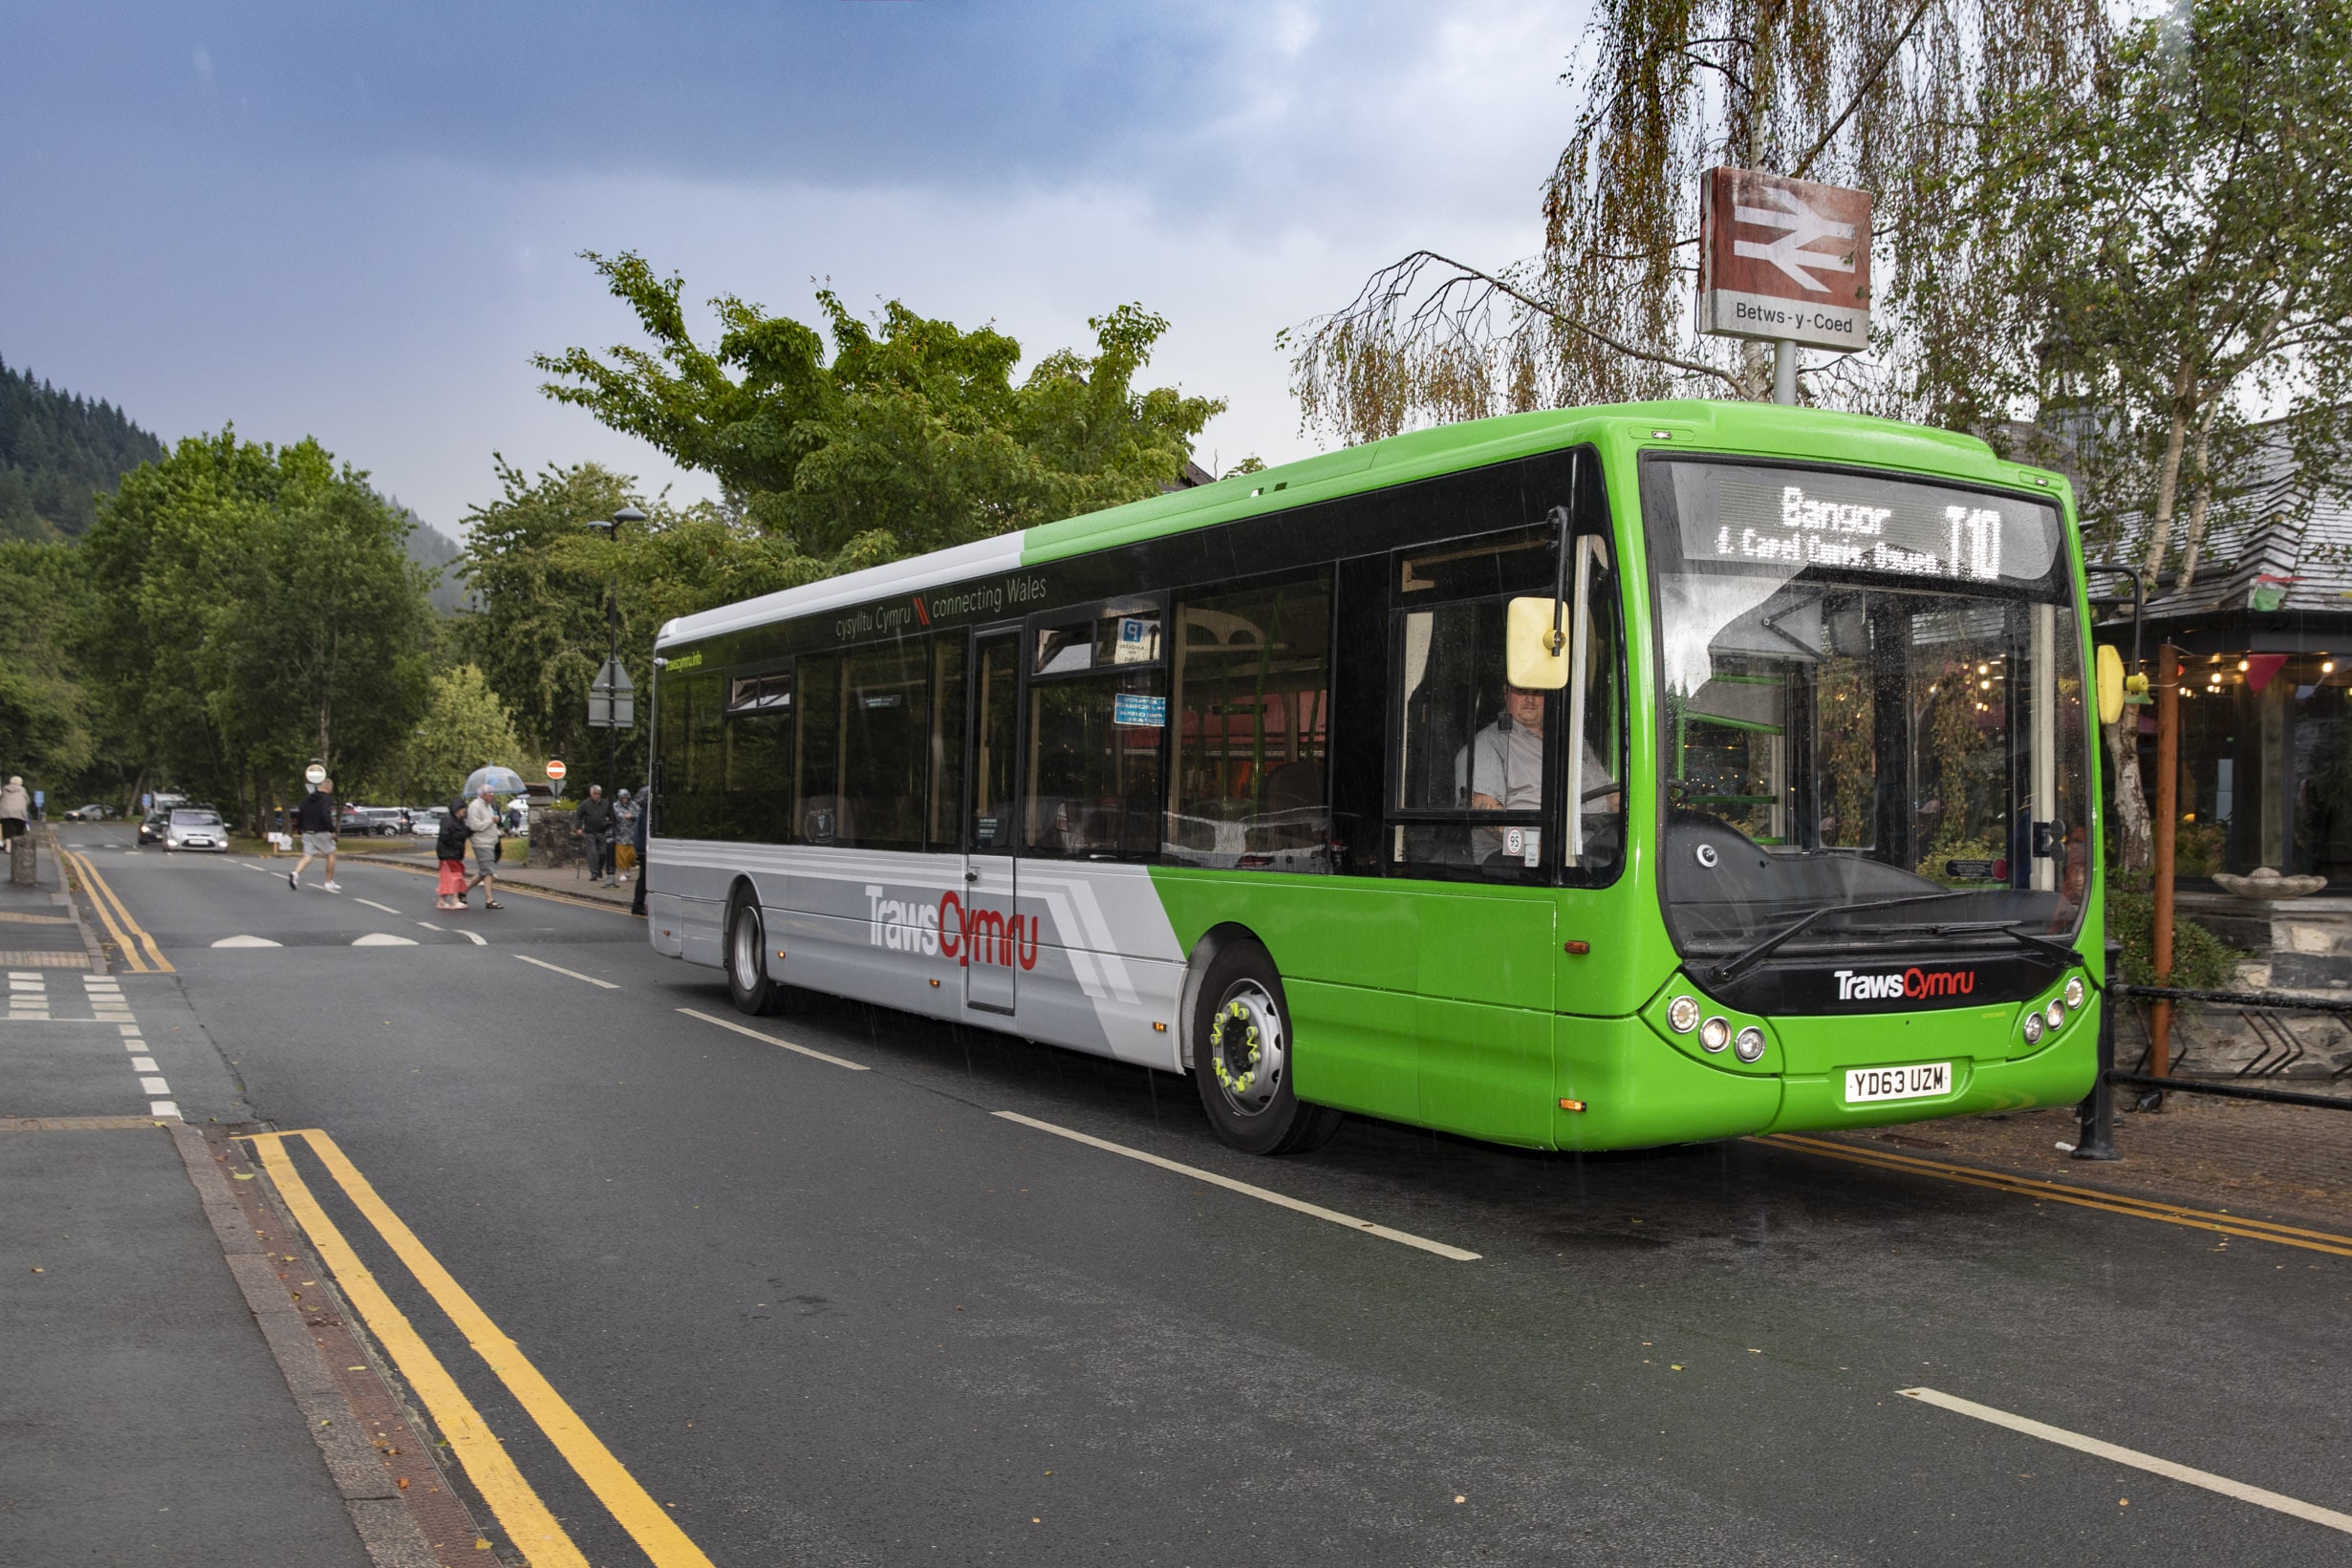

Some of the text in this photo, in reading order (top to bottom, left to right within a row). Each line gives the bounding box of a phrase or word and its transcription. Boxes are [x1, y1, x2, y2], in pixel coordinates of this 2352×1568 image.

[1736, 302, 1853, 333] Betws-y-Coed
[1781, 486, 1892, 536] Bangor
[1945, 505, 2002, 581] T10
[835, 575, 1047, 642] cysylltu Cymru connecting Wales
[1510, 835, 1520, 848] 95
[865, 885, 1039, 971] TrawsCymru
[1834, 967, 1974, 1000] TrawsCymru
[1854, 1066, 1943, 1096] YD63 UZM
